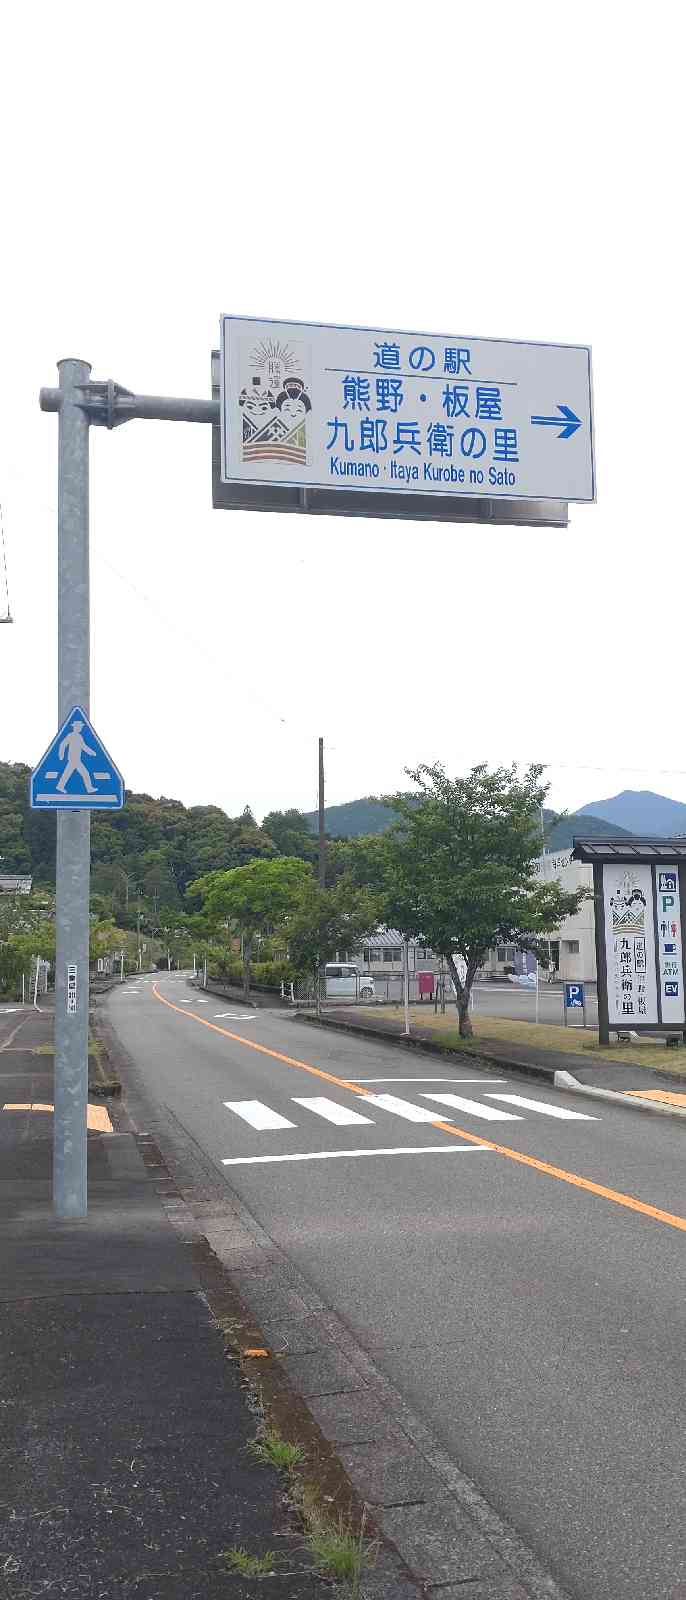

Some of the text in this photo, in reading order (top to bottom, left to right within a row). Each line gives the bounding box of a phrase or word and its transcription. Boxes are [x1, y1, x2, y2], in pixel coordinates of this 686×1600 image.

[373, 342, 472, 375] 道の駅
[341, 375, 503, 421] 熊野・板屋
[325, 416, 520, 463] 九郎兵衛の里
[330, 457, 380, 478] Kumano
[390, 460, 419, 484] Itaya
[424, 464, 465, 482] Kurobe
[470, 469, 484, 484] no
[488, 467, 516, 486] Sato
[663, 895, 674, 912] P
[663, 968, 678, 976] ATM
[569, 986, 580, 999] P
[666, 984, 678, 993] EV
